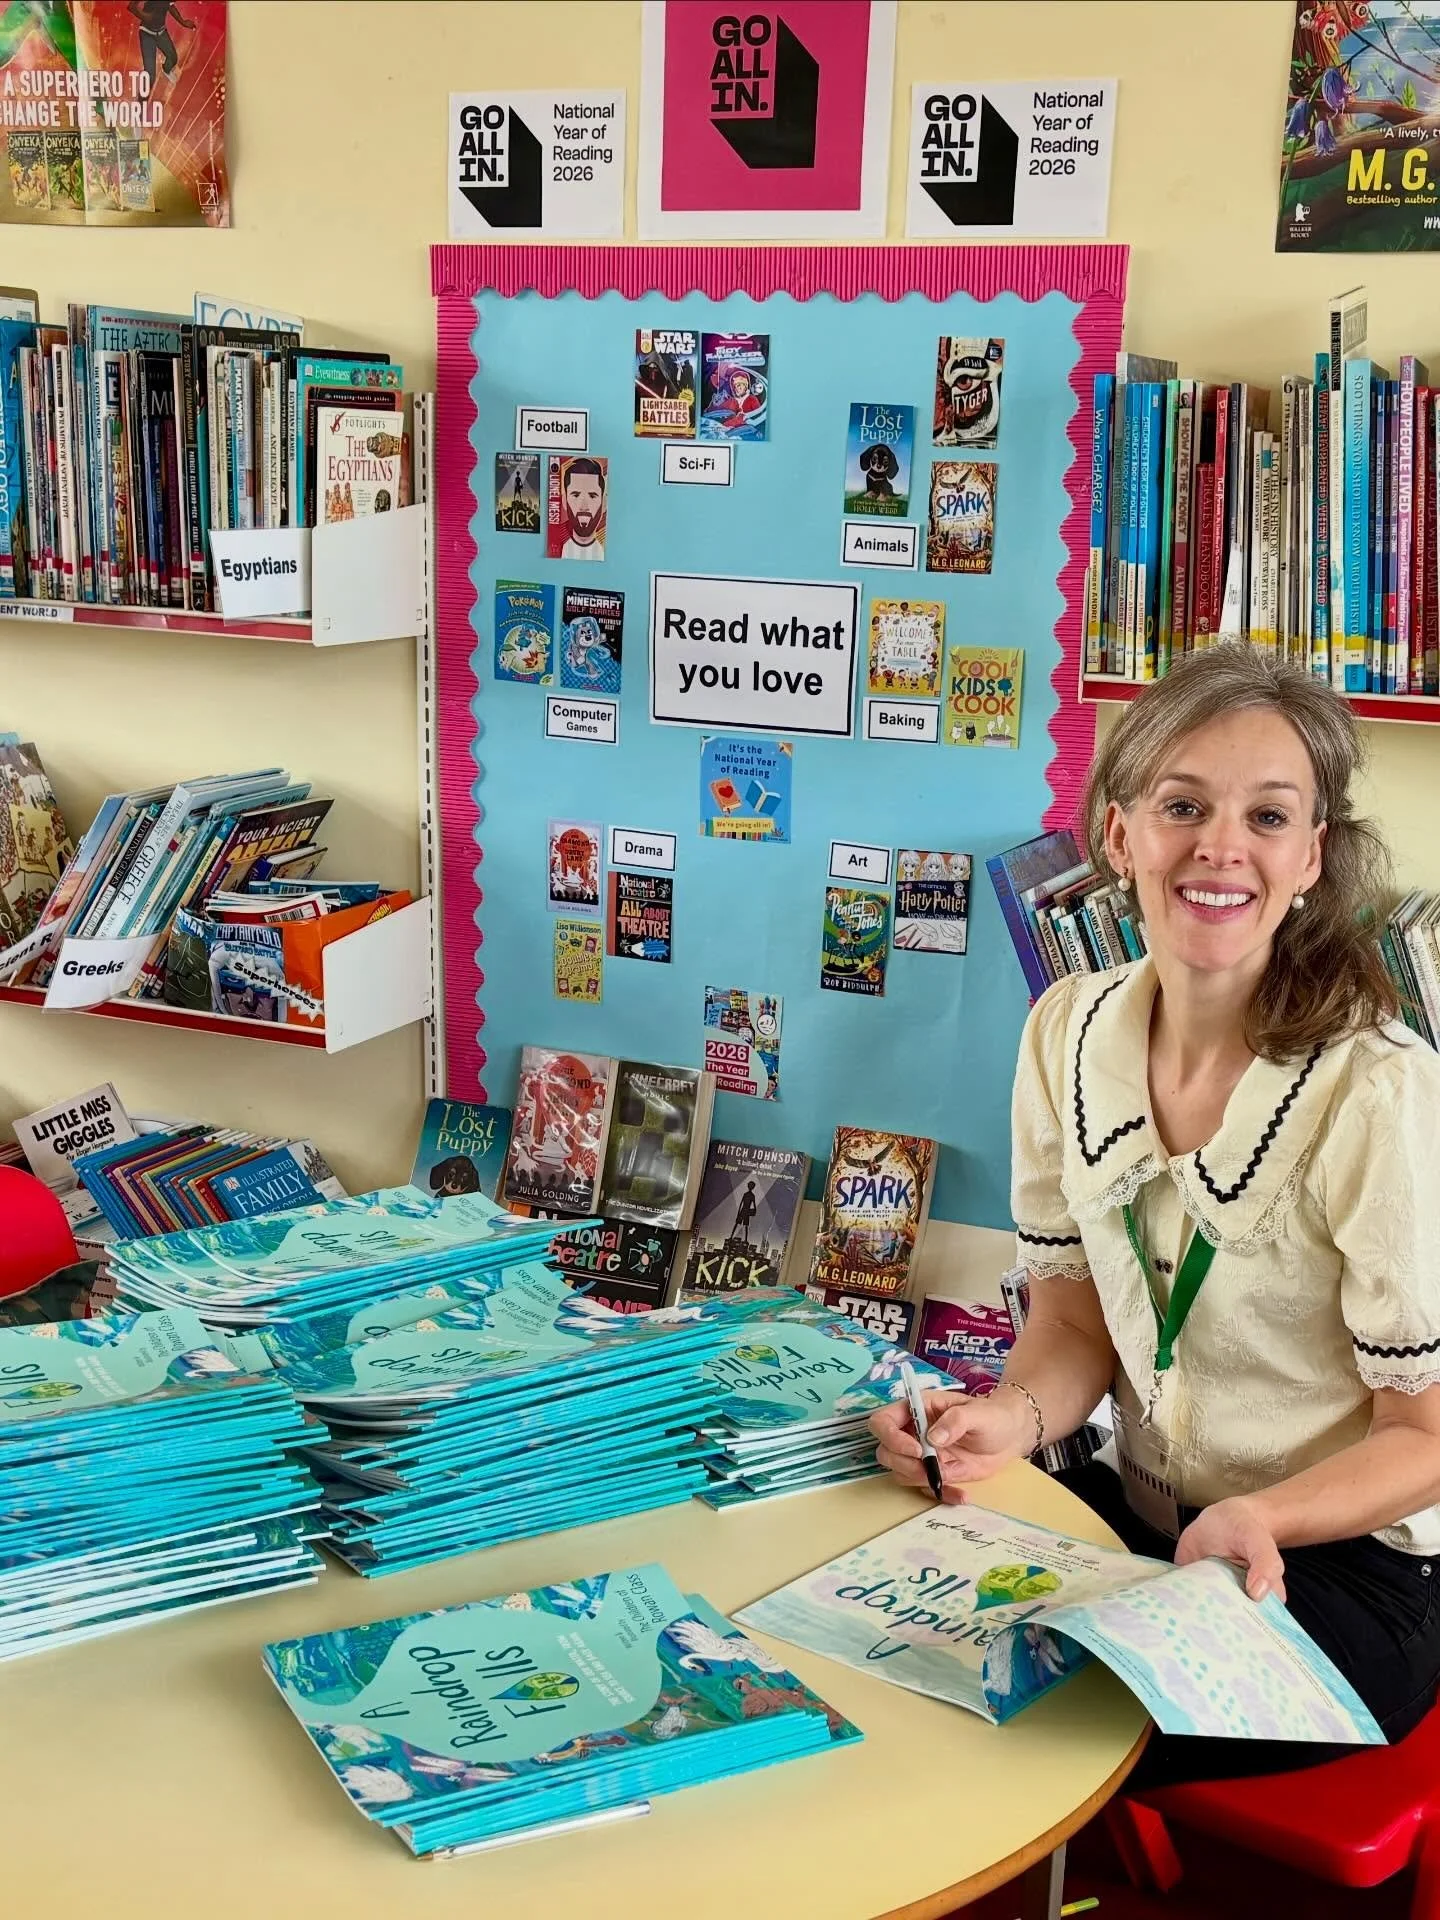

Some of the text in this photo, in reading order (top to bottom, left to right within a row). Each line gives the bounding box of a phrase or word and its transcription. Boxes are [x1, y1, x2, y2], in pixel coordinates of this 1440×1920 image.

[712, 15, 772, 47] GO
[710, 48, 770, 80] ALL
[3, 70, 150, 98] A SUPERHERO TO
[710, 81, 769, 113] IN.
[923, 93, 977, 122] GO
[1033, 90, 1104, 109] National
[66, 101, 97, 127] THE
[103, 101, 163, 128] WORLD
[460, 105, 505, 130] GO
[553, 102, 615, 120] National
[1032, 113, 1093, 131] Year of
[458, 131, 504, 156] ALL
[554, 124, 606, 140] Year of
[921, 122, 975, 150] ALL
[1398, 126, 1430, 141] lively,
[552, 145, 614, 164] Reading
[1029, 136, 1099, 157] Reading
[459, 157, 505, 183] IN.
[552, 165, 594, 182] 2026
[920, 150, 973, 178] IN.
[1029, 157, 1076, 176] 2026
[1347, 148, 1436, 192] M. G.
[1347, 194, 1439, 208] Bestselling author
[101, 327, 129, 351] THE
[653, 343, 696, 355] WARS
[655, 332, 696, 344] STAR
[94, 381, 102, 417] EGYPTIAN
[288, 390, 296, 428] EGYPTIAN
[642, 400, 688, 411] LIGHTSABER
[874, 406, 890, 416] The
[954, 387, 989, 415] TYGER
[527, 419, 578, 434] Football
[642, 411, 688, 425] BATTLES
[345, 435, 367, 459] THE
[1398, 381, 1413, 513] HOW PEOPLE LIVED
[270, 432, 278, 508] ANCIENT EGYPT
[328, 455, 393, 482] EGYPTIANS
[679, 457, 715, 471] Sci-Fi
[1092, 408, 1106, 514] Who's CHARGE?
[60, 463, 70, 518] ANCIENT EGYPT
[548, 474, 561, 525] LIONEL MESSI
[1316, 390, 1328, 606] WHAT HAPPENED WHEN WORLD
[1351, 401, 1364, 598] THINGS YOU SHOULD KNOW ABOUT
[936, 491, 989, 518] SPARK
[1269, 449, 1280, 559] CLOTHES HISTORY
[501, 509, 535, 527] KICK
[854, 536, 909, 553] Animals
[1175, 471, 1189, 604] THE MONEY ALVIN
[1199, 475, 1213, 610] PIRATE'S HANDBOOK
[1261, 477, 1271, 611] WHAT WE WORE STEWART ROSS
[1415, 497, 1425, 600] ENCYCLOPEDIA HISTORY
[220, 557, 298, 582] Egyptians
[22, 604, 58, 618] WORLD
[566, 595, 622, 610] MINECRAFT
[664, 608, 845, 650] Read what
[892, 646, 917, 658] TABLE
[678, 661, 823, 696] you love
[951, 676, 995, 697] KIDS
[552, 704, 613, 722] Computer
[953, 695, 1016, 717] COOK
[566, 721, 599, 734] Games
[879, 712, 925, 730] Baking
[714, 753, 777, 767] National Year
[729, 743, 763, 754] It's the
[720, 765, 770, 780] of Reading
[236, 815, 321, 843] YOUR ANCIENT
[625, 841, 663, 857] Drama
[848, 854, 868, 868] Art
[118, 844, 157, 905] GREECE
[620, 875, 654, 890] National
[620, 899, 642, 917] ALL
[899, 890, 967, 913] Harry Potter
[617, 916, 670, 939] THEATRE
[851, 914, 883, 932] Jones
[62, 959, 125, 977] Greeks
[233, 961, 317, 1011] Superheroes
[706, 1041, 748, 1061] 2026
[706, 1061, 749, 1077] The Year
[716, 1076, 758, 1095] Reading
[31, 1095, 112, 1142] LITTLE MISS
[443, 1103, 498, 1139] Lost
[462, 1105, 481, 1118] The
[53, 1117, 115, 1155] GIGGLES
[436, 1132, 493, 1157] Puppy
[717, 1144, 799, 1165] MITCH JOHNSON
[241, 1158, 295, 1186] ILLUSTRATED
[233, 1169, 306, 1215] FAMILY
[518, 1185, 580, 1203] JULIA GOLDING
[835, 1175, 913, 1209] SPARK
[695, 1254, 770, 1288] KICK
[842, 1269, 897, 1290] LEONARD
[827, 1297, 908, 1324] STAR
[851, 1317, 906, 1342] ARS
[957, 1318, 969, 1326] THE
[969, 1320, 997, 1331] PHOENIX
[945, 1329, 1004, 1347] TROY
[713, 1356, 856, 1392] Raindrop
[795, 1388, 823, 1404] A
[626, 1573, 648, 1595] Class
[622, 1595, 645, 1625] Children
[641, 1594, 669, 1624] Rowan
[835, 1577, 994, 1648] aindrop
[866, 1636, 911, 1661] A
[408, 1644, 508, 1750] Raindrop
[359, 1700, 411, 1720] A
